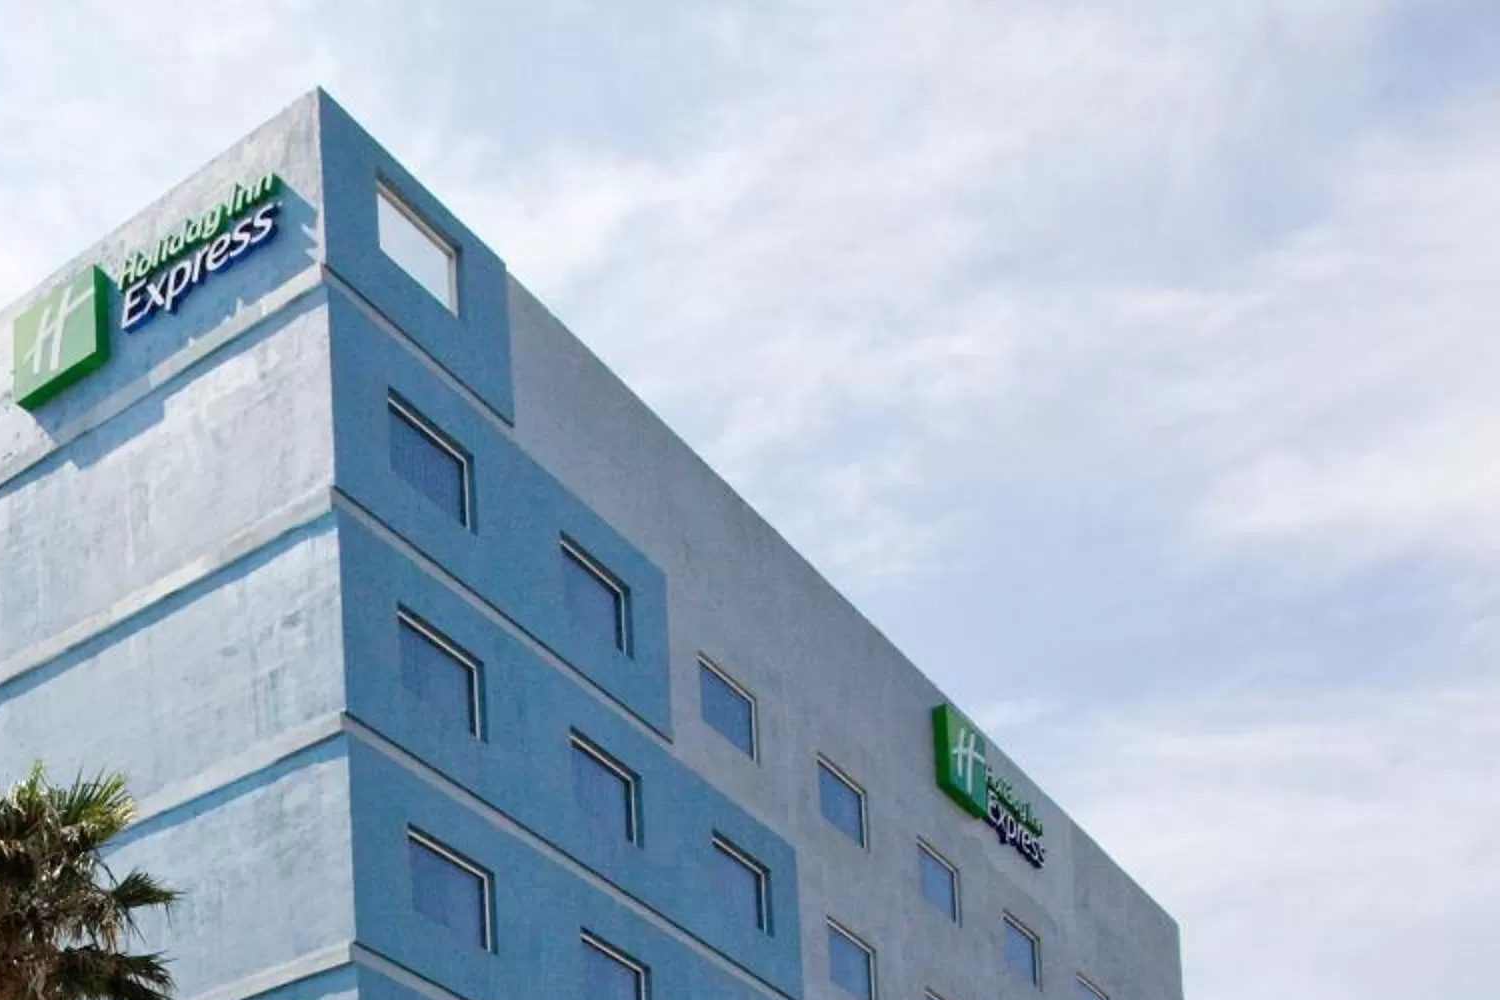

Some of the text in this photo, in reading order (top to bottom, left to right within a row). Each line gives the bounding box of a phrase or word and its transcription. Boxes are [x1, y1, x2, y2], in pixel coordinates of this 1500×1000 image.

[117, 171, 275, 291] Holiday Inn
[120, 201, 277, 330] Express
[986, 787, 1045, 868] Express
